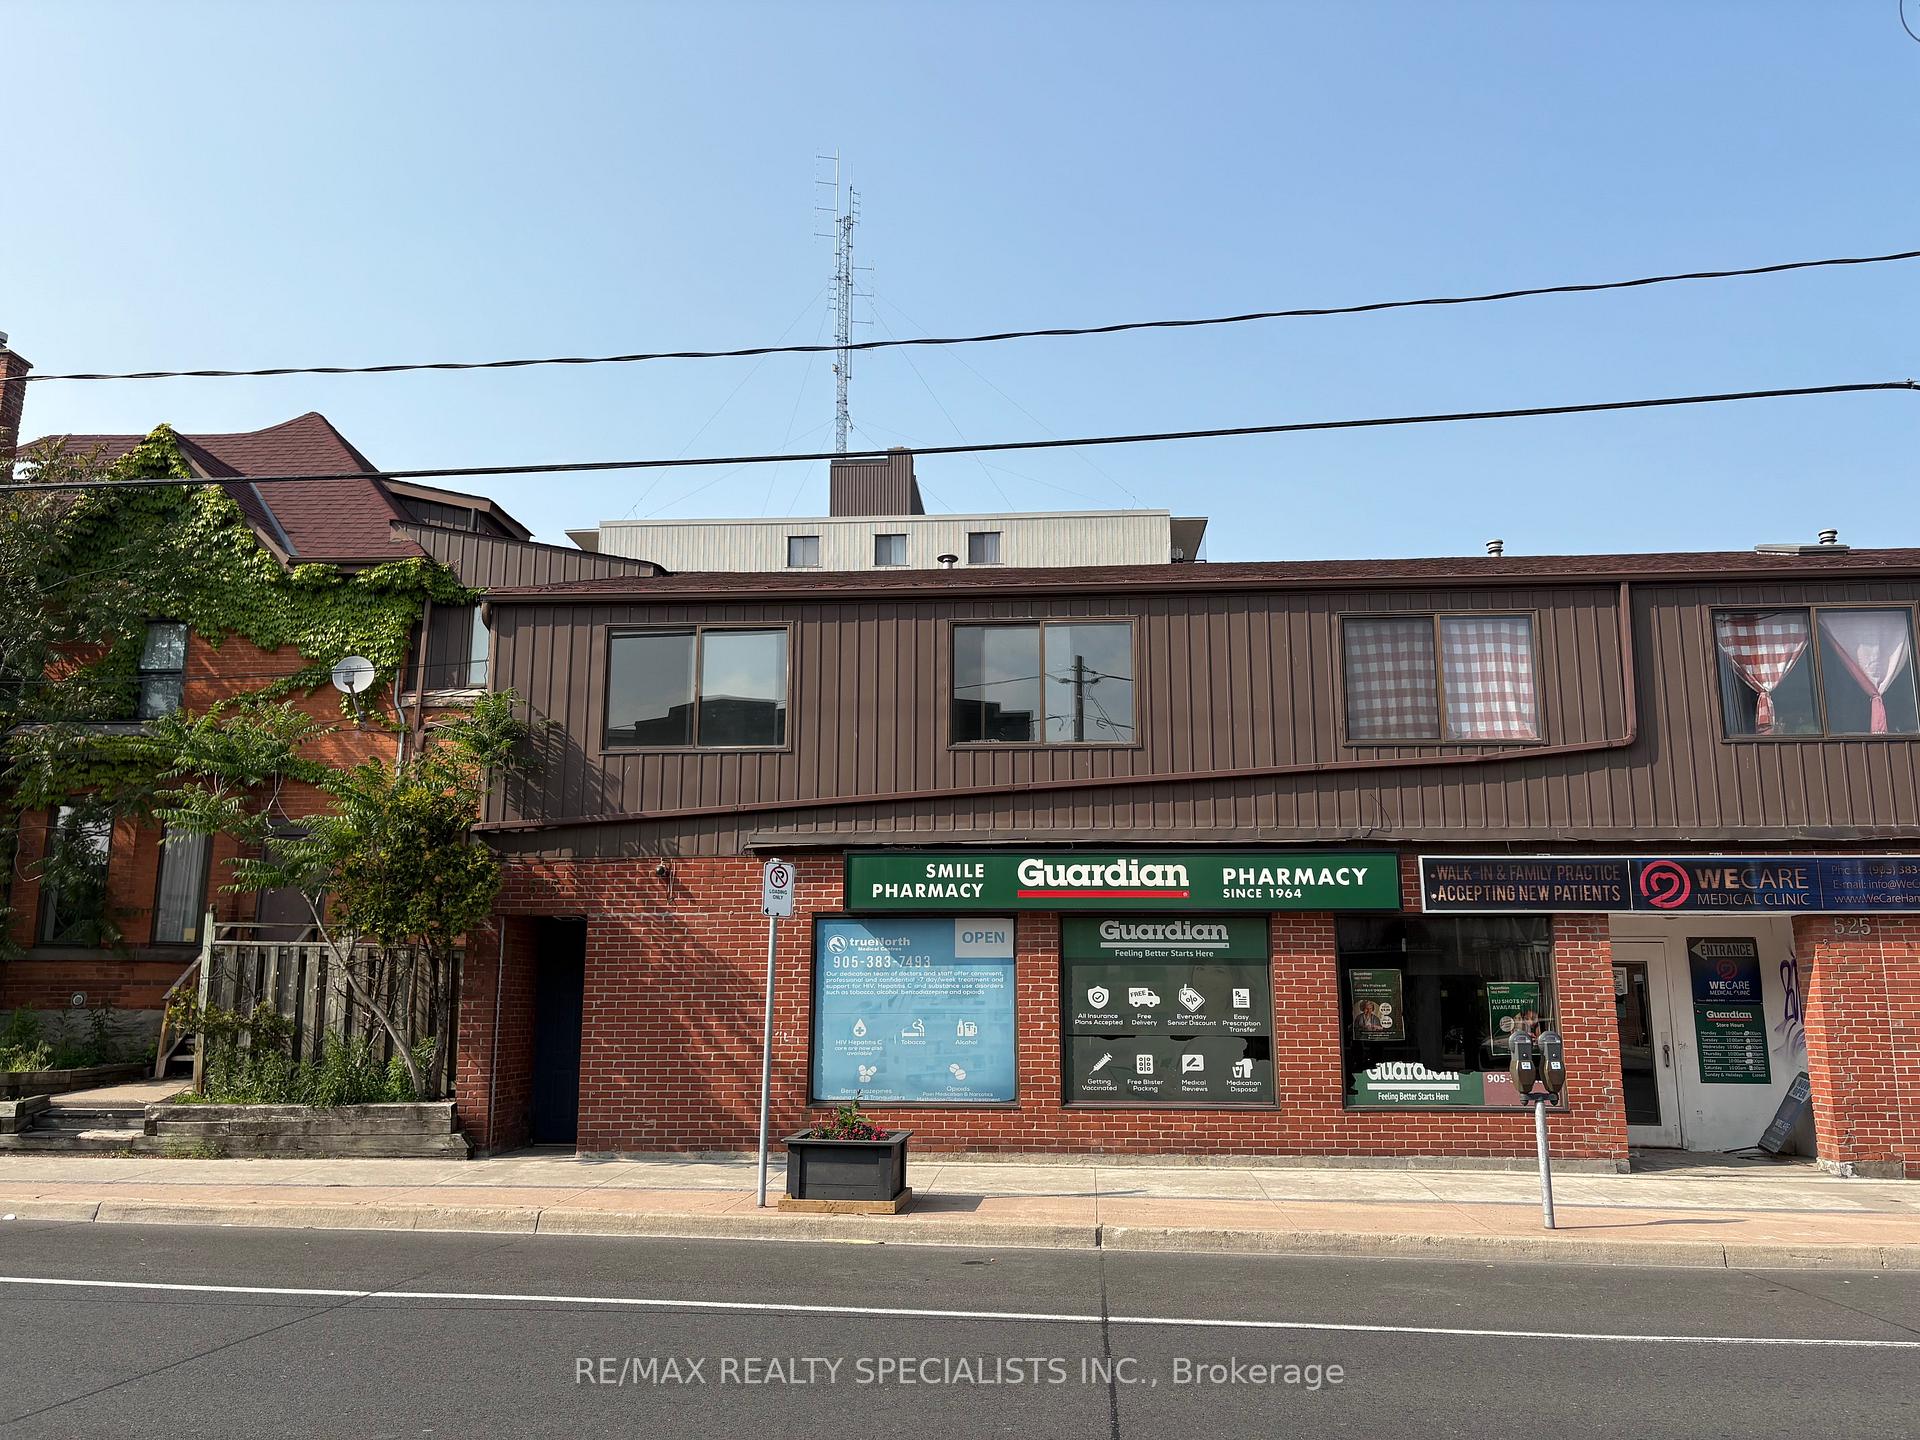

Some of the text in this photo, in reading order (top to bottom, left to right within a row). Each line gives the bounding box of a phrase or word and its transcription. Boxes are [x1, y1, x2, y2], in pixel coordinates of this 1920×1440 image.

[925, 863, 985, 879] SMILE
[1017, 858, 1189, 887] Guardian
[1223, 868, 1368, 886] PHARMACY
[1436, 864, 1621, 881] WALK-IN & FAMILY PRACTICE
[1695, 867, 1809, 889] WECARE
[1833, 879, 1867, 889] E-mail:
[871, 883, 985, 898] PHARMACY
[1223, 888, 1302, 898] SINCE 1964
[1437, 884, 1621, 901] ACCEPTING NEW PATIENTS
[1697, 893, 1811, 905] MEDICAL CLINIC
[1099, 920, 1229, 940] Guardian
[1833, 917, 1872, 935] 525
[850, 937, 911, 946] trueNorth
[961, 931, 1006, 944] OPEN
[1115, 950, 1143, 958] Feeling
[1700, 944, 1753, 956] ENTRANCE
[833, 955, 931, 968] 905-383-7493
[1708, 980, 1751, 989] WECARE
[1177, 1013, 1206, 1021] Everyday
[1706, 1010, 1753, 1019] Guardian
[1087, 1078, 1111, 1086] Getting
[1133, 1085, 1158, 1093] Packing
[1378, 1092, 1449, 1102] Feeling Better Starts Here
